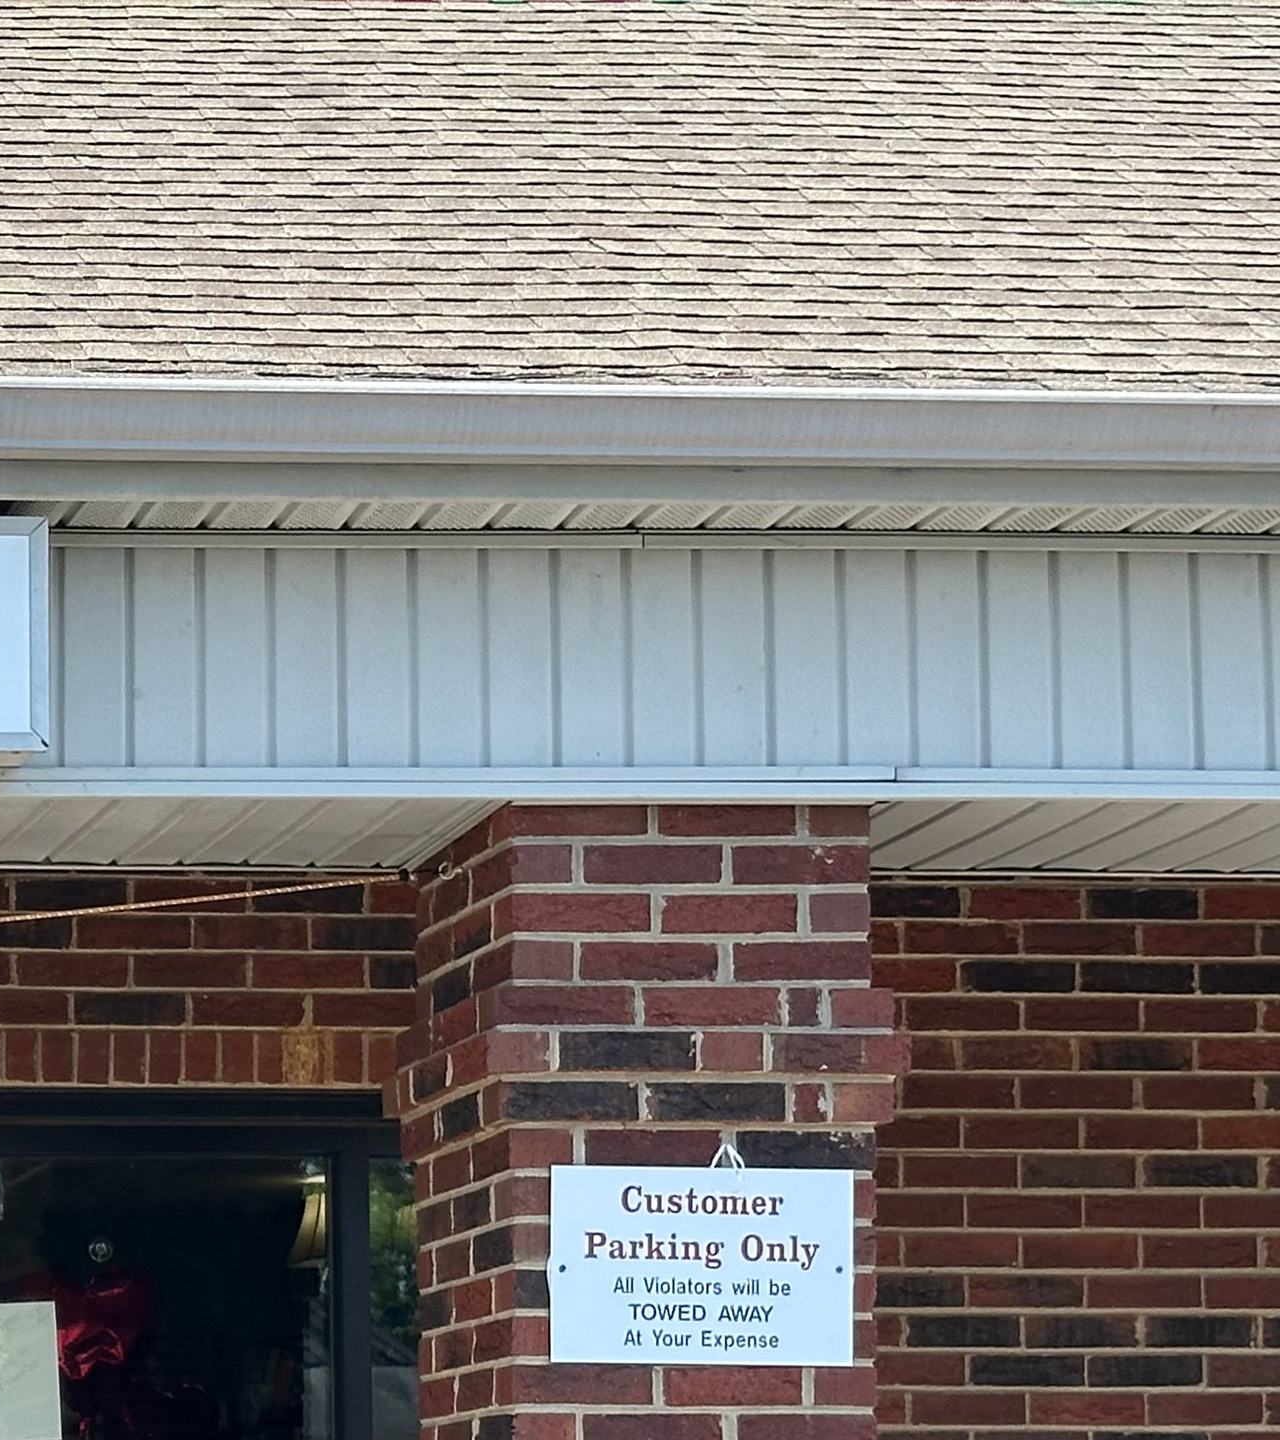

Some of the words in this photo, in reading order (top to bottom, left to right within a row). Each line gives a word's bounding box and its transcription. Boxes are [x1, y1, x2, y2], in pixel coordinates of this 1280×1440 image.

[621, 1185, 785, 1216] Customer
[583, 1231, 726, 1269] Parking
[741, 1234, 821, 1271] Only
[613, 1277, 635, 1295] All
[643, 1277, 723, 1296] Violators
[732, 1279, 761, 1296] will
[769, 1279, 792, 1297] be
[627, 1303, 707, 1322] TOWED
[718, 1304, 775, 1323] AWAY
[624, 1330, 643, 1347] At
[652, 1329, 692, 1348] Your
[701, 1331, 780, 1352] Expense
